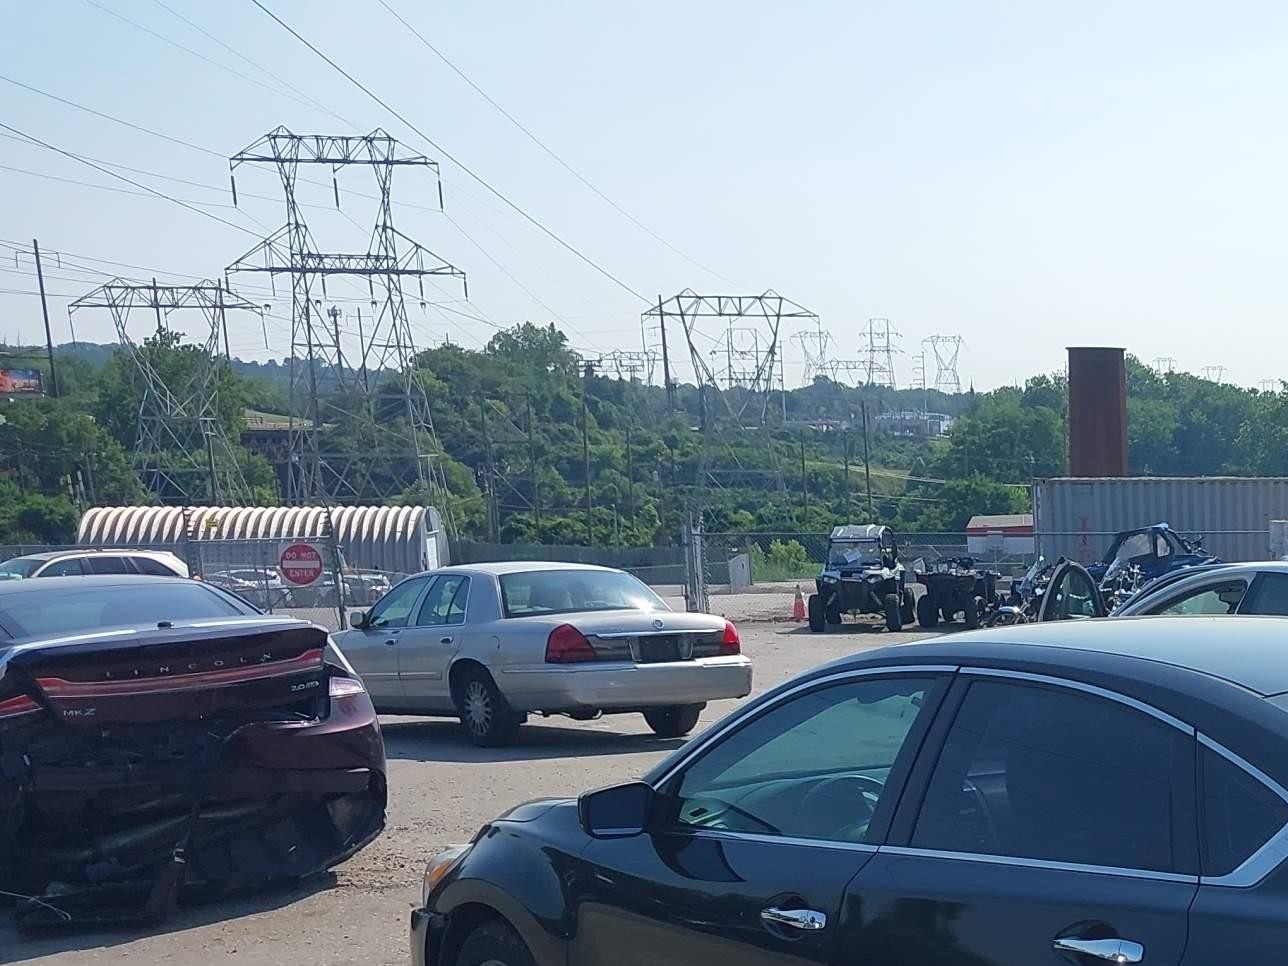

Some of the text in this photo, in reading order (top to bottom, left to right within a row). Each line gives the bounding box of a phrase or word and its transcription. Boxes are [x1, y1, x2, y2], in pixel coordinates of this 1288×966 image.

[285, 551, 316, 560] DO NOT
[289, 569, 315, 578] ENTER
[106, 652, 272, 678] LINCOLN
[63, 708, 97, 716] MKZ
